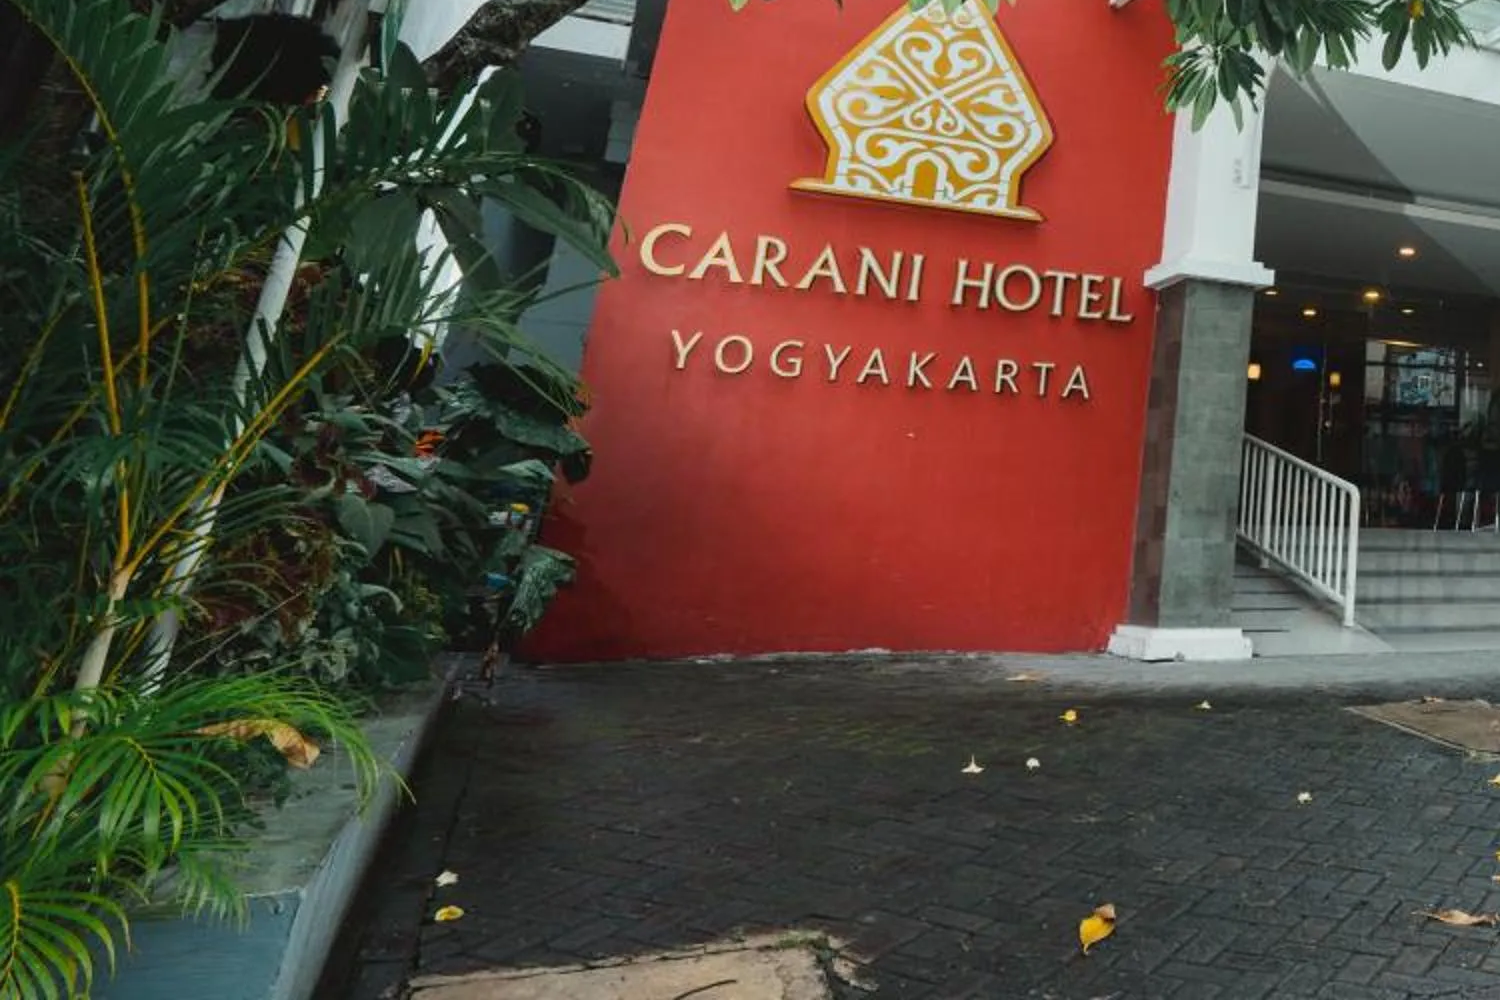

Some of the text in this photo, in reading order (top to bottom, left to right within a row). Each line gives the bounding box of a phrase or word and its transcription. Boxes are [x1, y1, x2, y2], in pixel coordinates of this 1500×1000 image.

[640, 223, 1132, 322] CARANI HOTEL
[671, 329, 1090, 400] YOGYAKARTA
